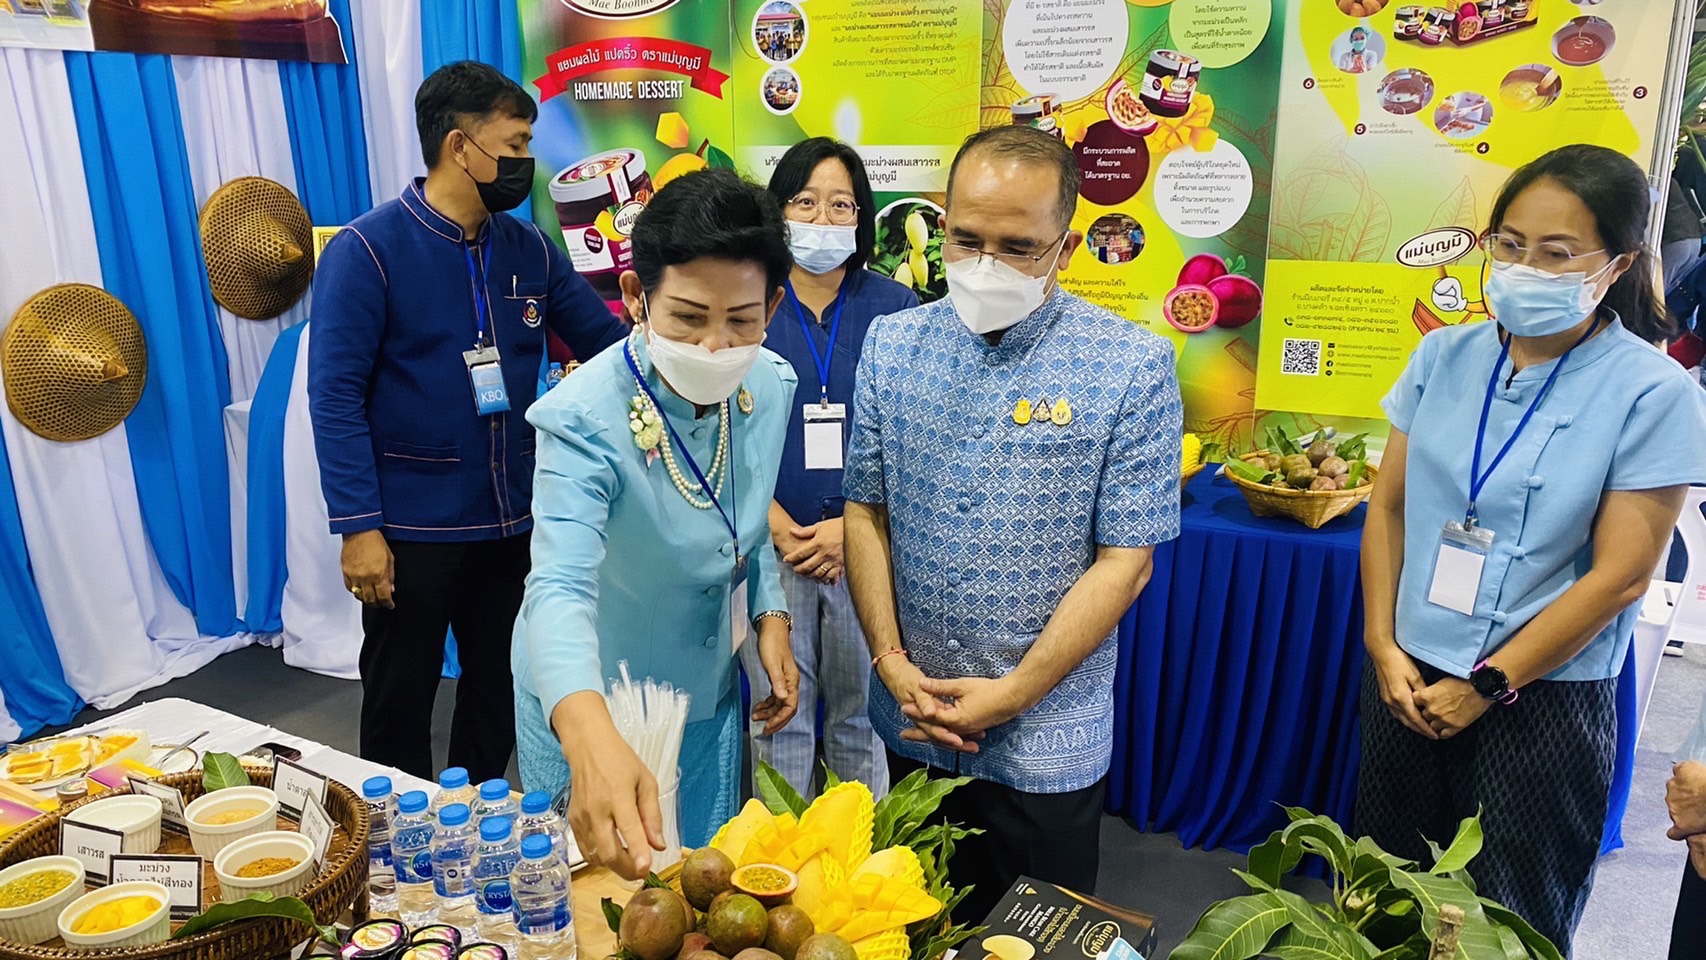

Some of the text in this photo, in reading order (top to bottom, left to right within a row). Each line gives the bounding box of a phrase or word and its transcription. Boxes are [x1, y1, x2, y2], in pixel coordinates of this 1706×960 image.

[557, 43, 702, 72] แยมผลไม้ แปดริ้ว ตราแม่บุญมี
[574, 80, 685, 100] HOMEMADE DESSERT
[863, 155, 941, 167] มะม่วงผสมเสาวรส
[1405, 233, 1462, 259] แม่บุญมี
[481, 389, 504, 404] KBO
[77, 844, 105, 859] เสาวรส
[139, 863, 171, 873] มะม่วง
